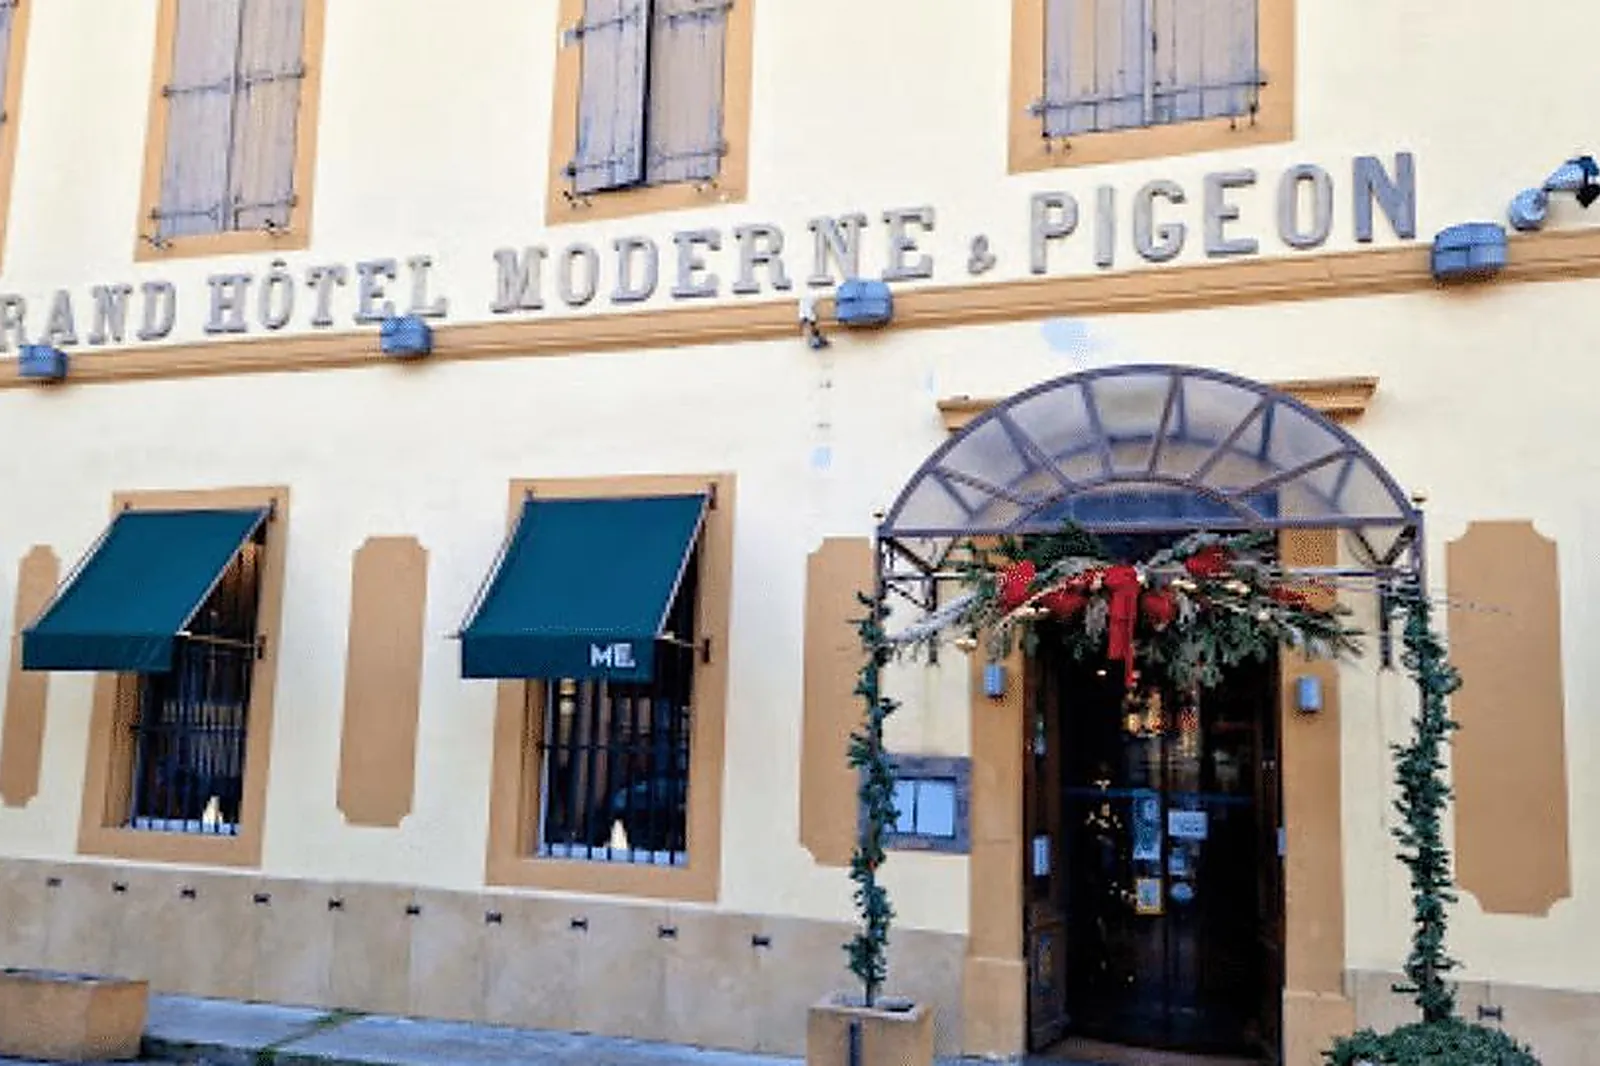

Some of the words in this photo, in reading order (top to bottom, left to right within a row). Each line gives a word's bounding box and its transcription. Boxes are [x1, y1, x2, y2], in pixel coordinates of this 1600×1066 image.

[205, 256, 448, 334] HÔTEL
[490, 206, 936, 314] MODERNE
[966, 234, 997, 275] &
[1030, 152, 1417, 274] PIGEON
